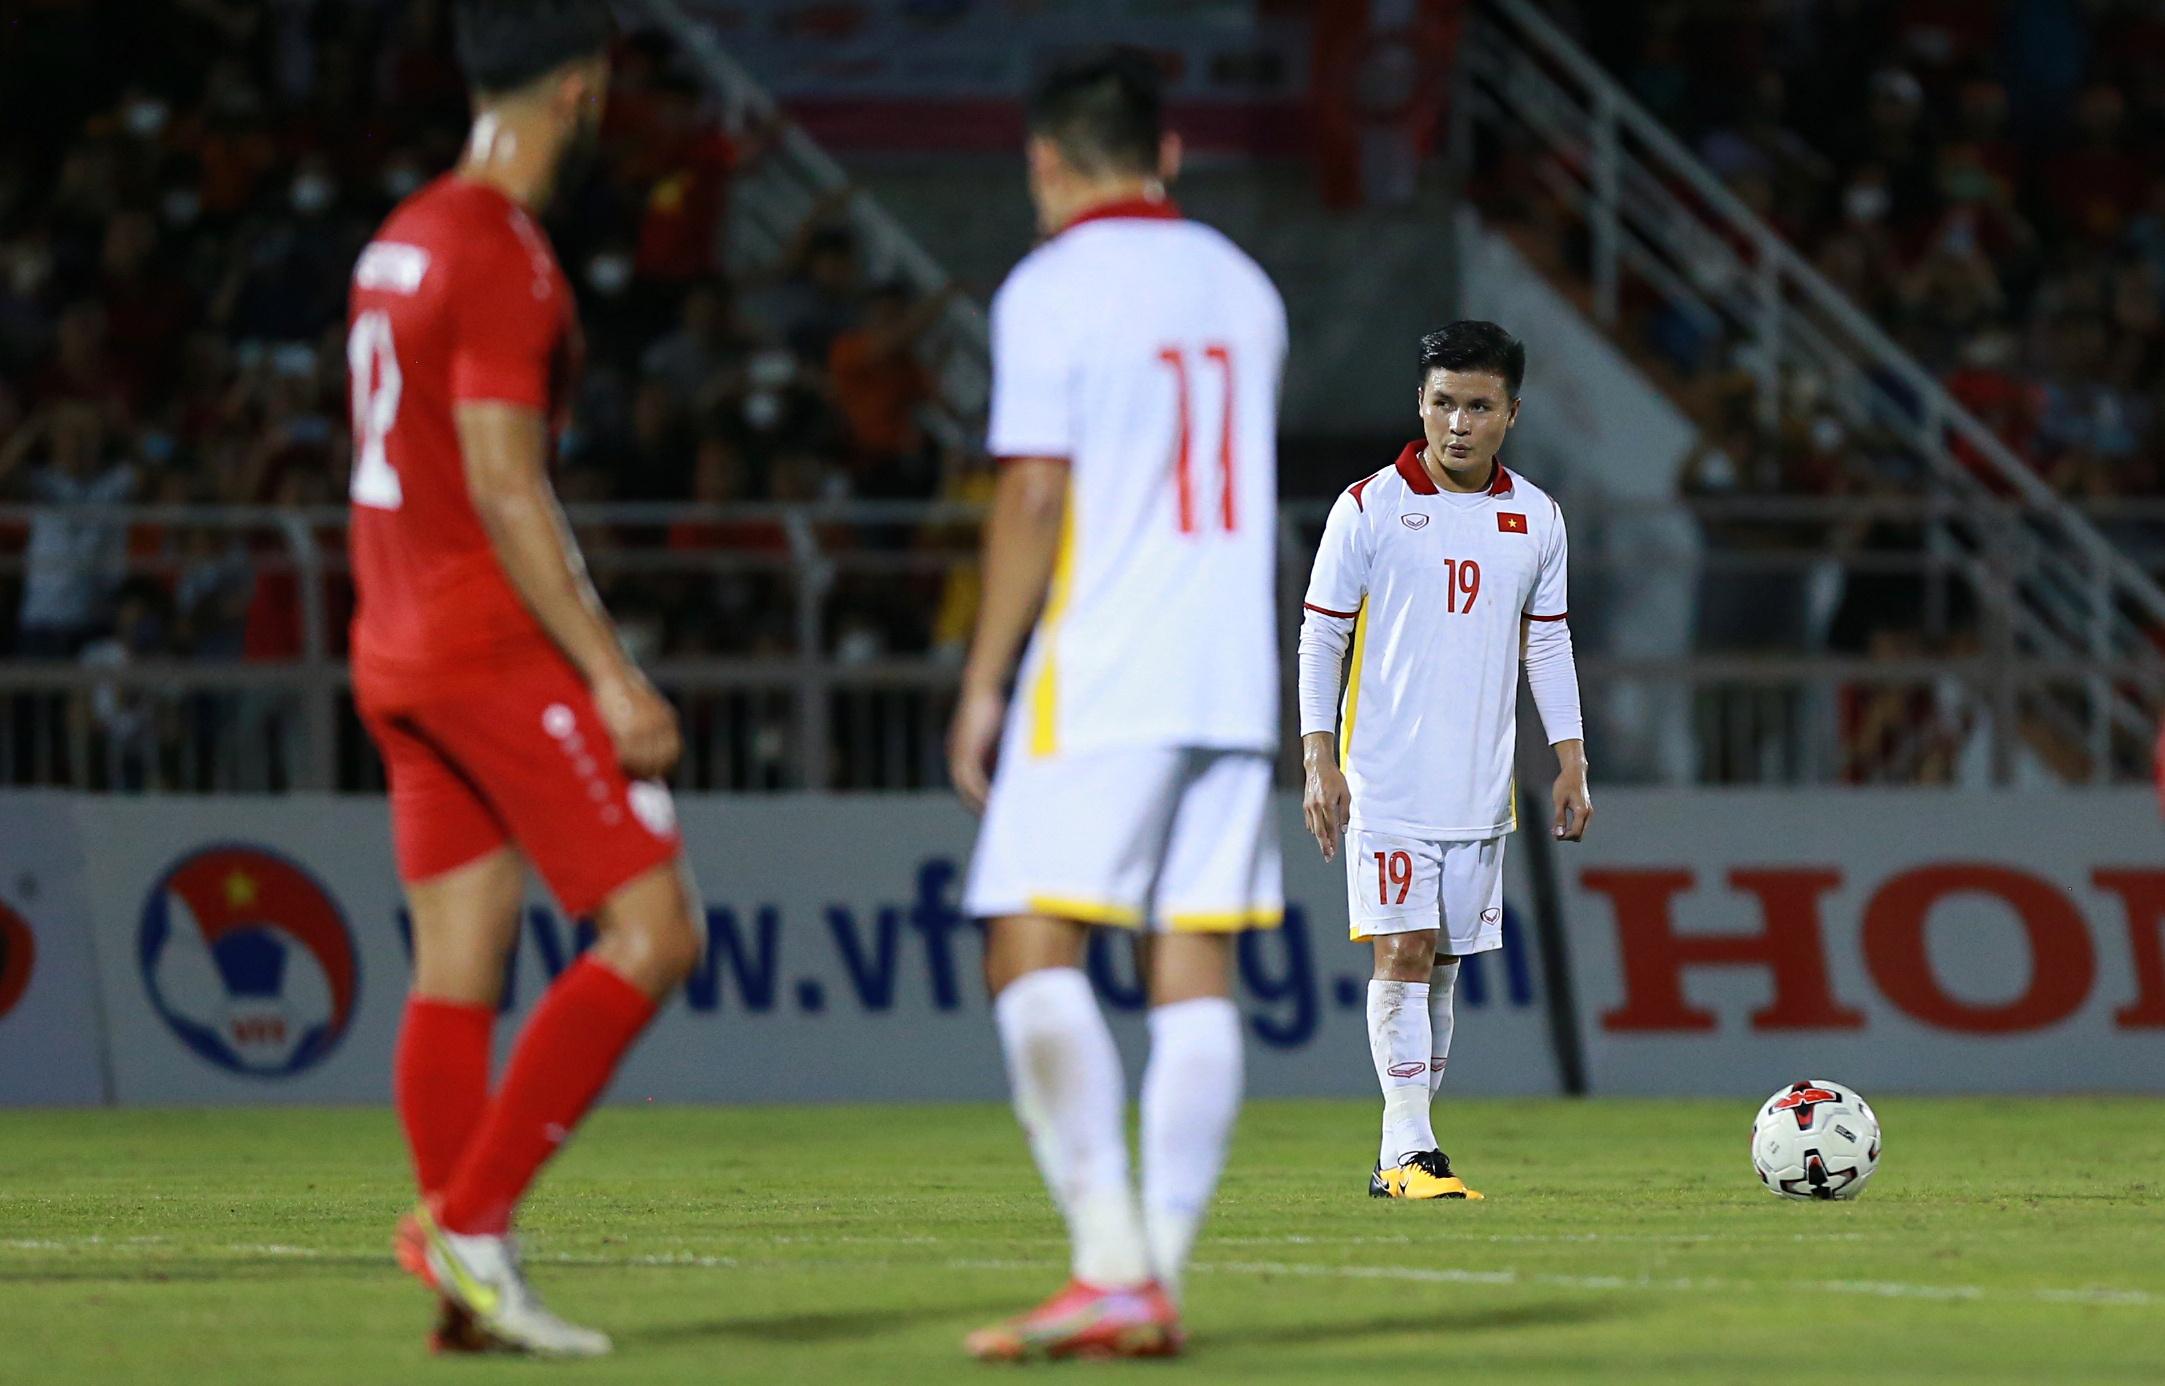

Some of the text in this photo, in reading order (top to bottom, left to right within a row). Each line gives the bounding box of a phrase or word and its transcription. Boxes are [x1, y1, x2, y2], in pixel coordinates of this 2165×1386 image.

[1157, 345, 1236, 534] 11
[1443, 558, 1481, 614] 19
[1373, 851, 1412, 906] 19
[1579, 860, 2165, 1036] HO
